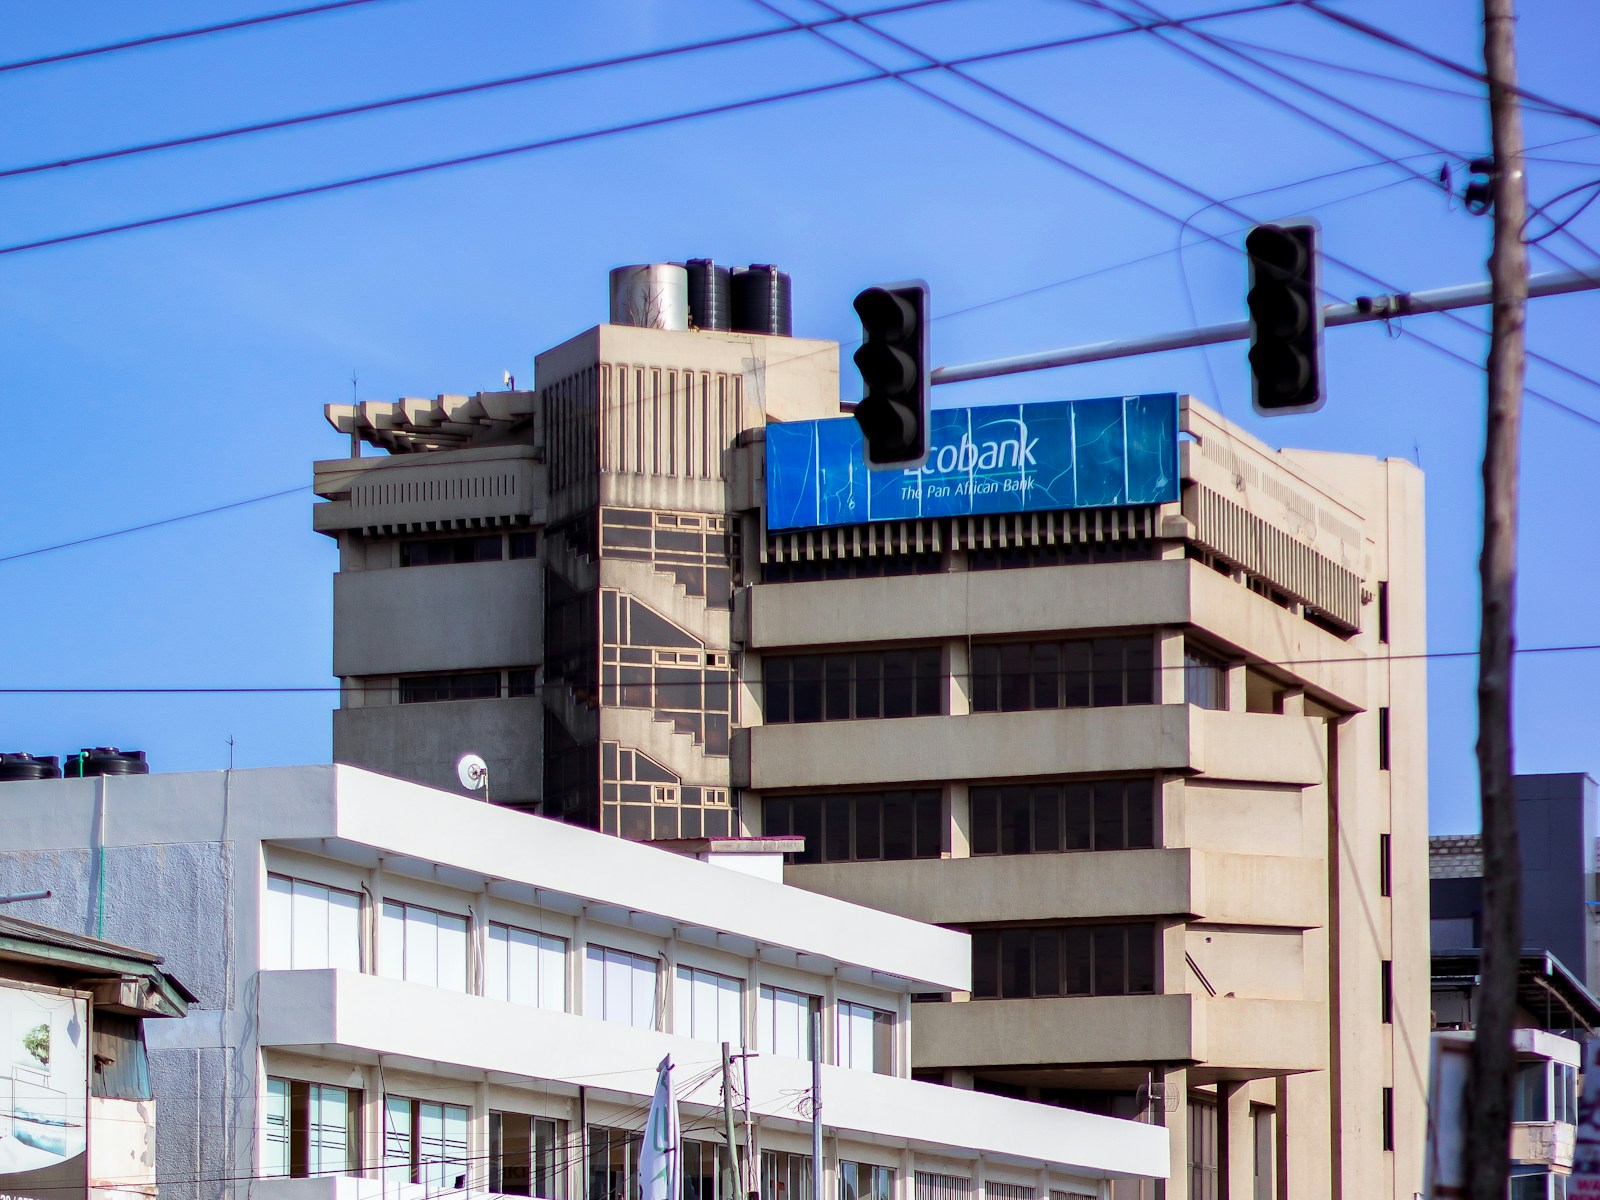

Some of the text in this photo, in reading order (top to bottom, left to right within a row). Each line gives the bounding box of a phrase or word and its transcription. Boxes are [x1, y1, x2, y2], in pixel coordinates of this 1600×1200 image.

[903, 427, 1039, 475] cobank
[902, 475, 1035, 500] The Pan African Bank
